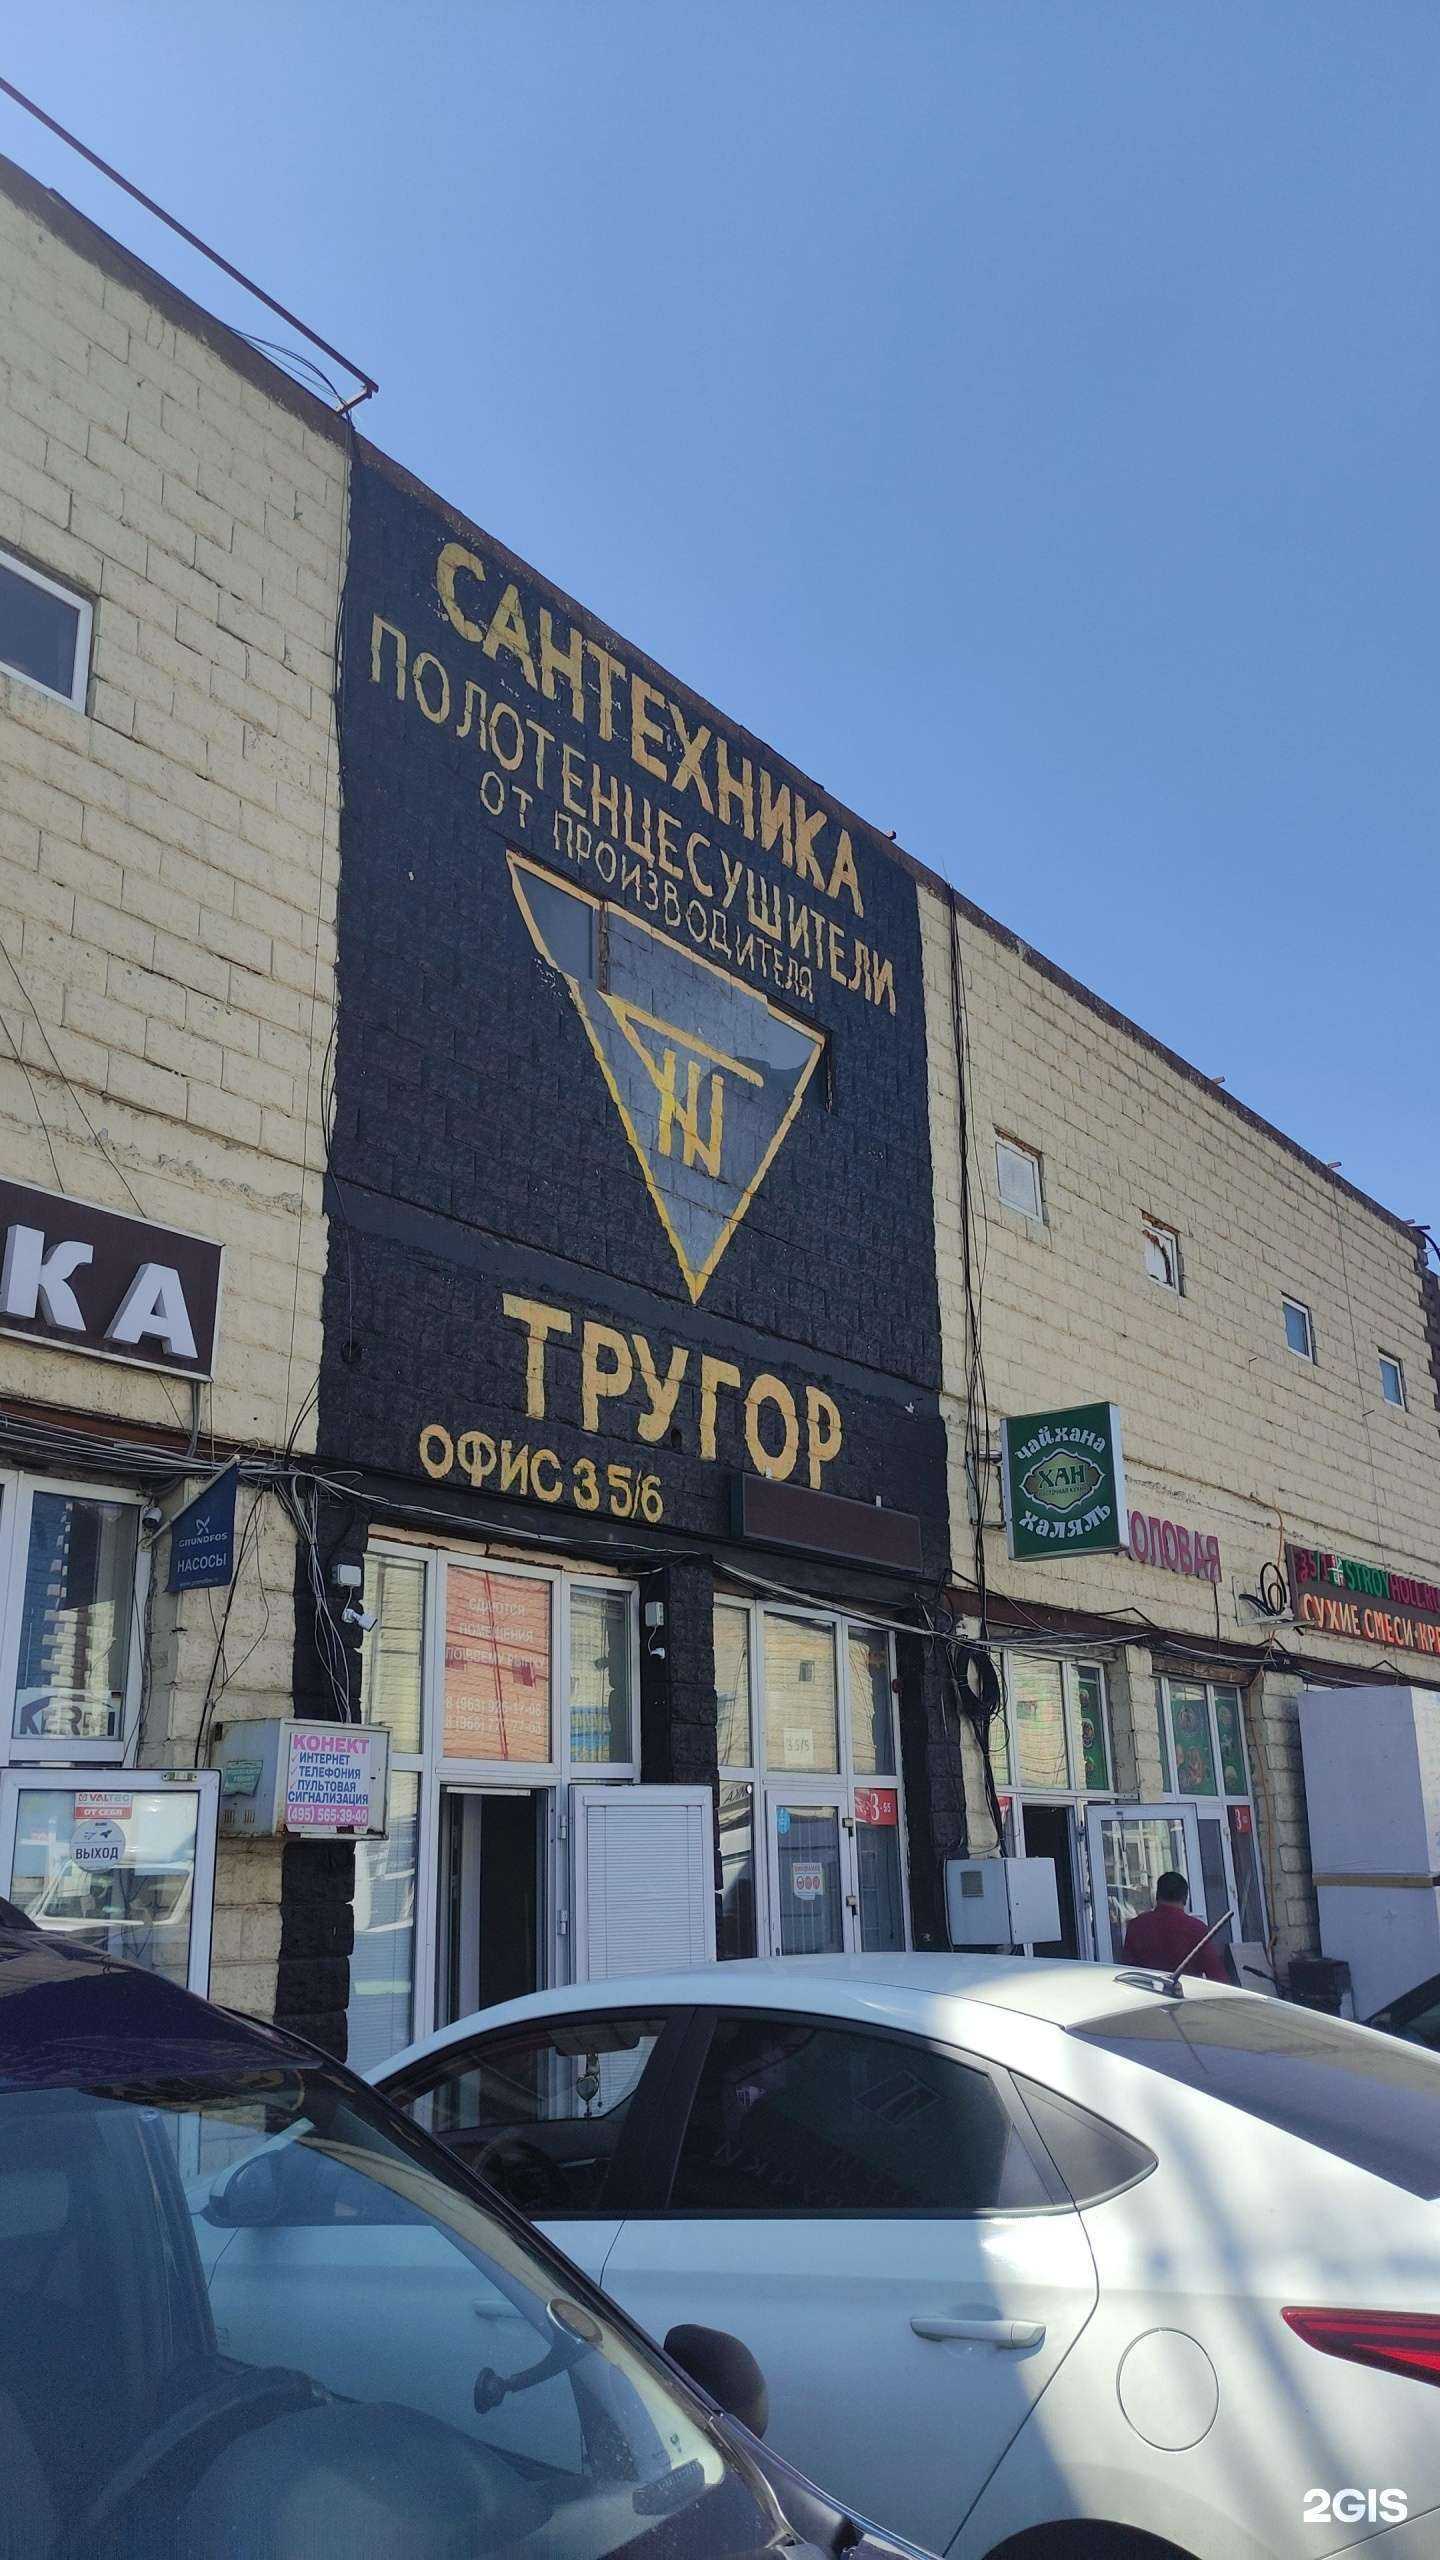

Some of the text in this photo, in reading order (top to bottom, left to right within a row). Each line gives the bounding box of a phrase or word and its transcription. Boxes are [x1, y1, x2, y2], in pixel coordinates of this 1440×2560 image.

[437, 543, 863, 918] САНТЕХНИКА
[371, 612, 897, 1016] ПОЛОТЕНЦЕСУШИТЕЛИ
[480, 771, 814, 1004] ОТ ПРОИЗВОДИТЕЛЯ
[0, 1223, 199, 1360] КА
[503, 1293, 843, 1490] ТРУГОР
[419, 1424, 563, 1502] ОФИС
[1038, 1465, 1086, 1489] ХАН
[1127, 1510, 1222, 1583] ОЛОВАЯ
[177, 1552, 227, 1573] НАСОСЫ
[1302, 1593, 1361, 1636] СУХИЕ
[1364, 1608, 1415, 1648] СМЕСИ
[293, 1734, 370, 1754] КОНЕКТ
[299, 1753, 351, 1766] ИНТЕРНЕТ
[299, 1766, 361, 1780] ТЕЛЕФОНИЯ
[288, 1791, 369, 1806] СИГНАЛИЗАЦИЯ
[297, 1780, 357, 1793] ПУЛЬТОВАЯ
[288, 1807, 315, 1824] (495)
[75, 1847, 119, 1860] ВЫХОД
